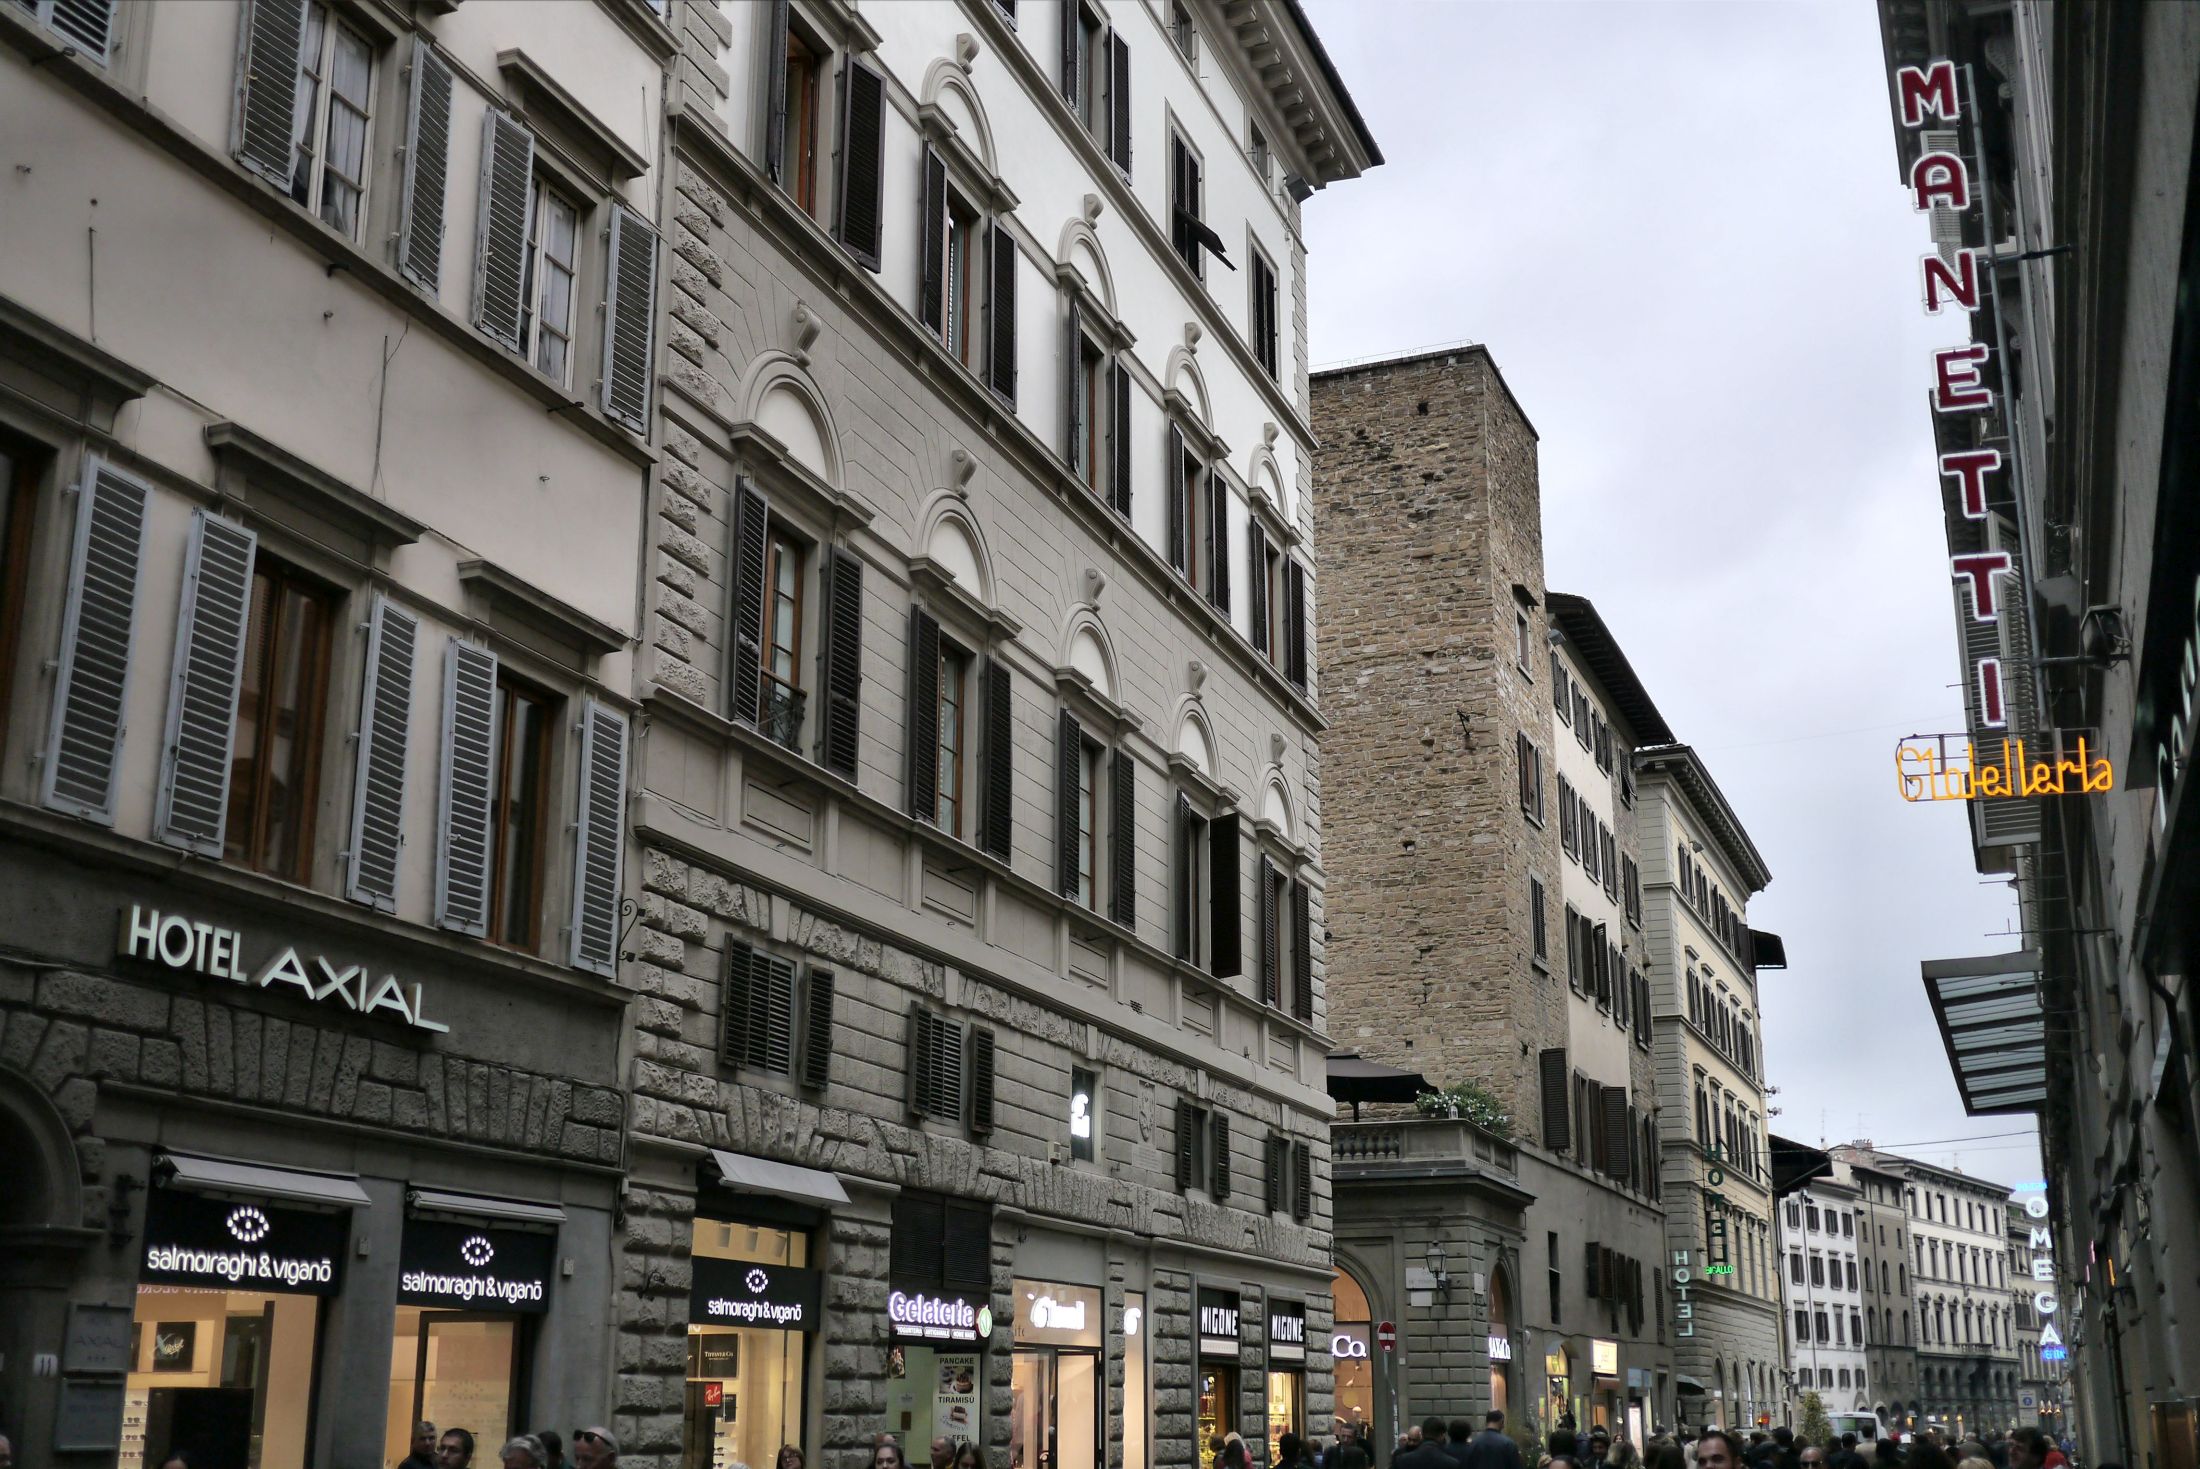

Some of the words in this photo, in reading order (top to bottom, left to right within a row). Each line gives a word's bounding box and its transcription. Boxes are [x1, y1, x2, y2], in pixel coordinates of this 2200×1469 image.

[1896, 60, 2012, 728] MANETTI
[127, 904, 247, 983] HOTEL
[259, 946, 450, 1033] AXIAL
[2025, 1196, 2062, 1346] OMEGA
[889, 1291, 975, 1327] Gelateria
[1201, 1306, 1238, 1336] MIGONE
[1271, 1315, 1304, 1342] MIGONE
[939, 1357, 974, 1365] PANCAKE
